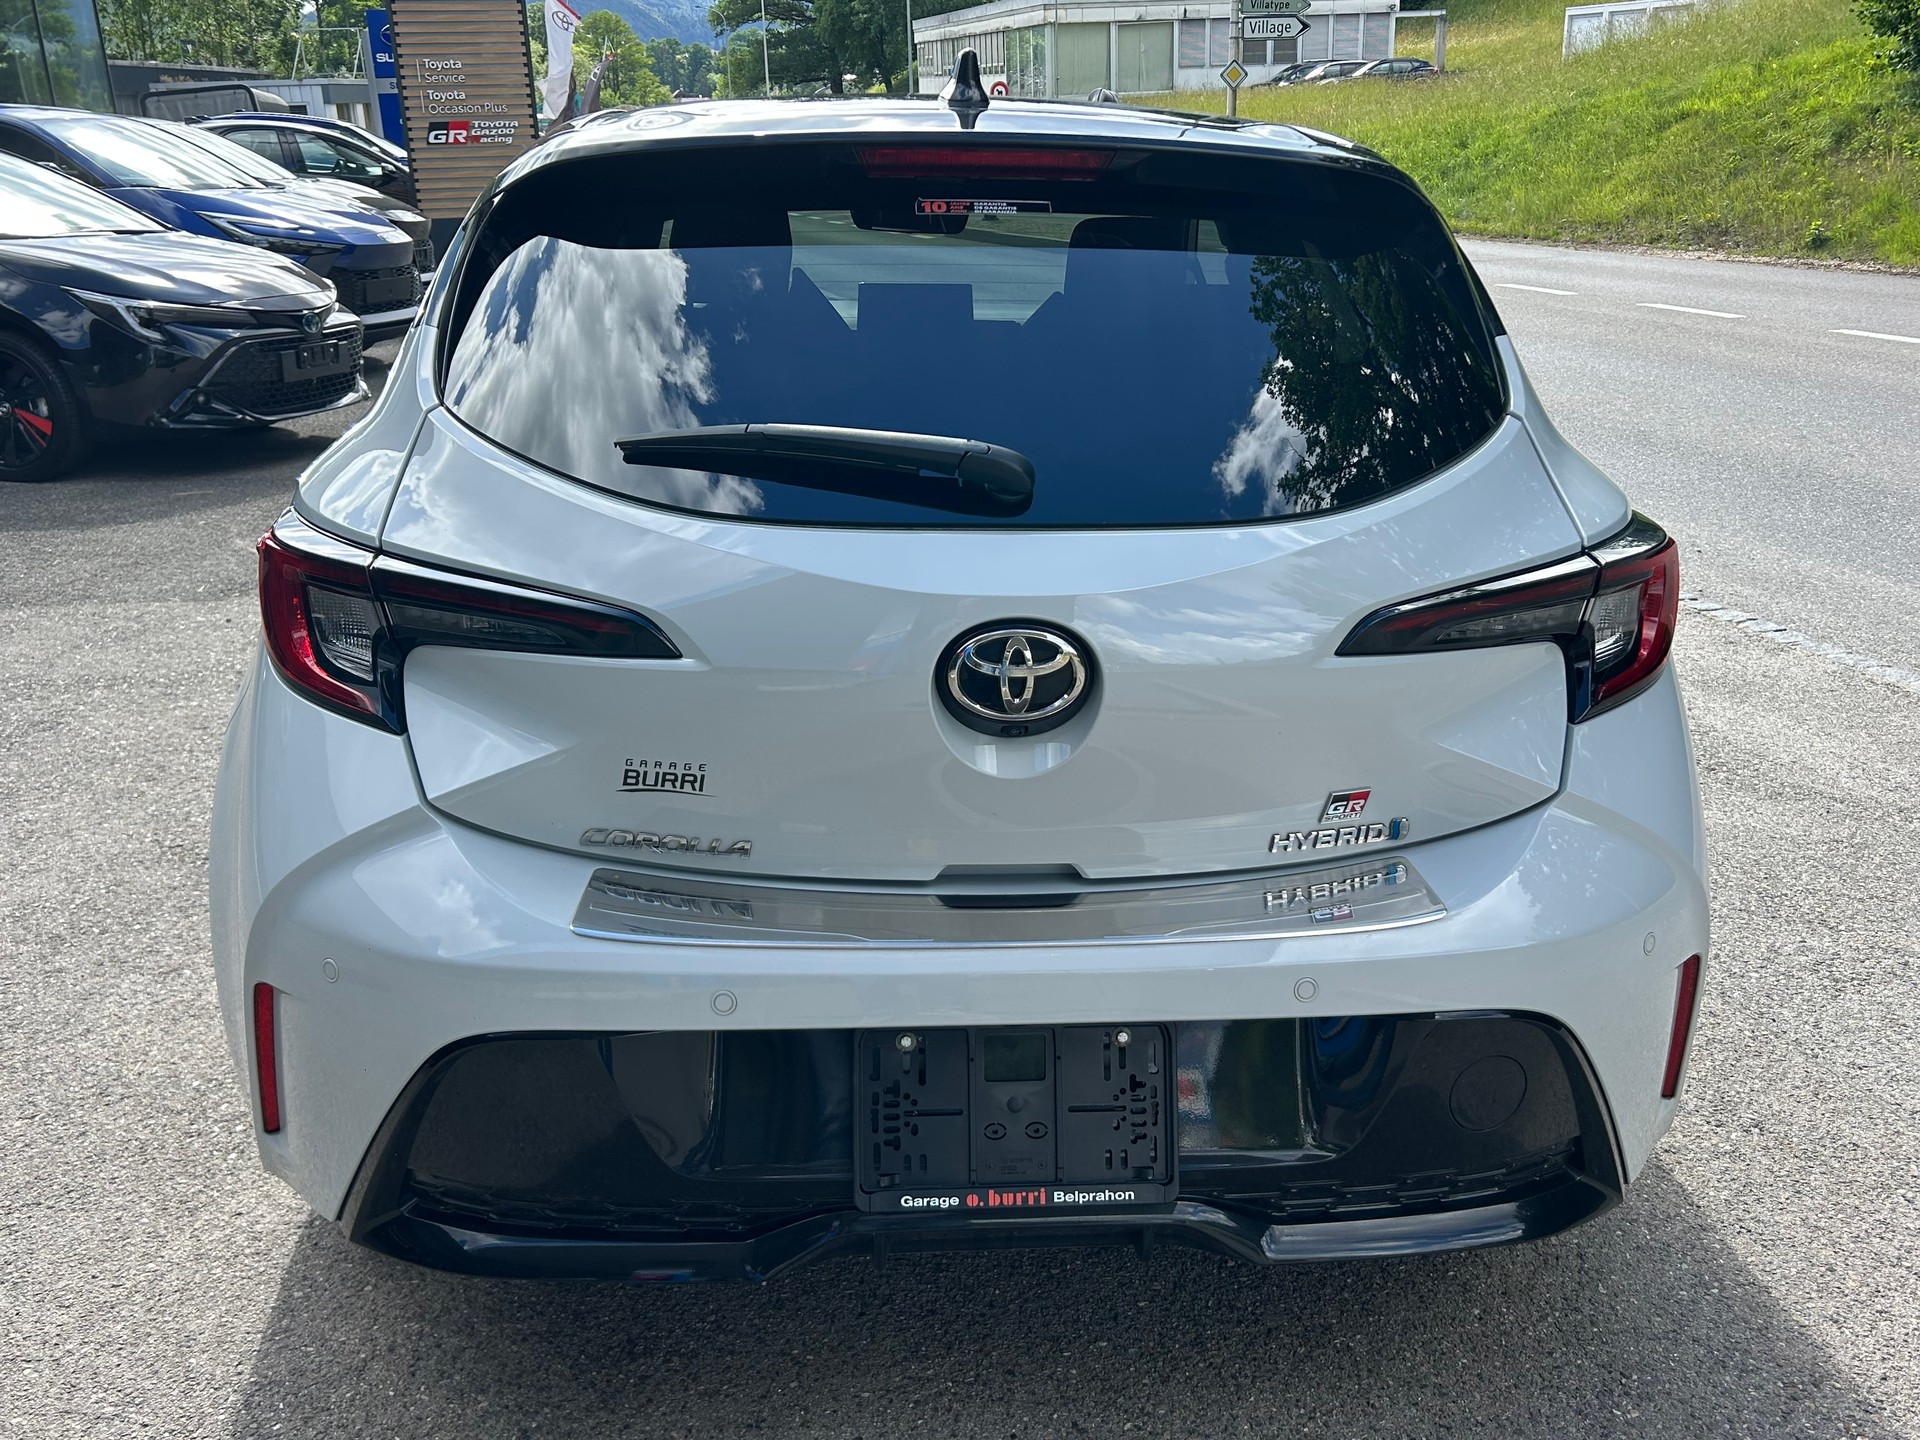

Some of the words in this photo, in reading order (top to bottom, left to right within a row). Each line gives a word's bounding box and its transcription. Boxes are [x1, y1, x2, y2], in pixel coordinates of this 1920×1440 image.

[1250, 0, 1290, 11] Villatype
[1249, 20, 1292, 36] Village
[423, 58, 462, 70] Toyota
[424, 72, 466, 84] Service
[427, 90, 466, 102] Toyota
[428, 102, 482, 115] Occasion
[484, 102, 508, 114] Plus
[472, 120, 519, 128] TOYOTA
[428, 129, 468, 144] GR
[471, 127, 515, 136] GAZOO
[471, 135, 513, 145] Racing
[921, 201, 947, 213] 10
[625, 758, 707, 772] GARAGE
[622, 768, 706, 792] BURRI
[1327, 799, 1366, 815] GR
[1323, 813, 1361, 822] SPORT
[579, 827, 753, 858] COROLLA
[1269, 822, 1390, 853] HYBRID
[900, 1195, 960, 1208] Garage
[1053, 1189, 1135, 1204] Belprahon
